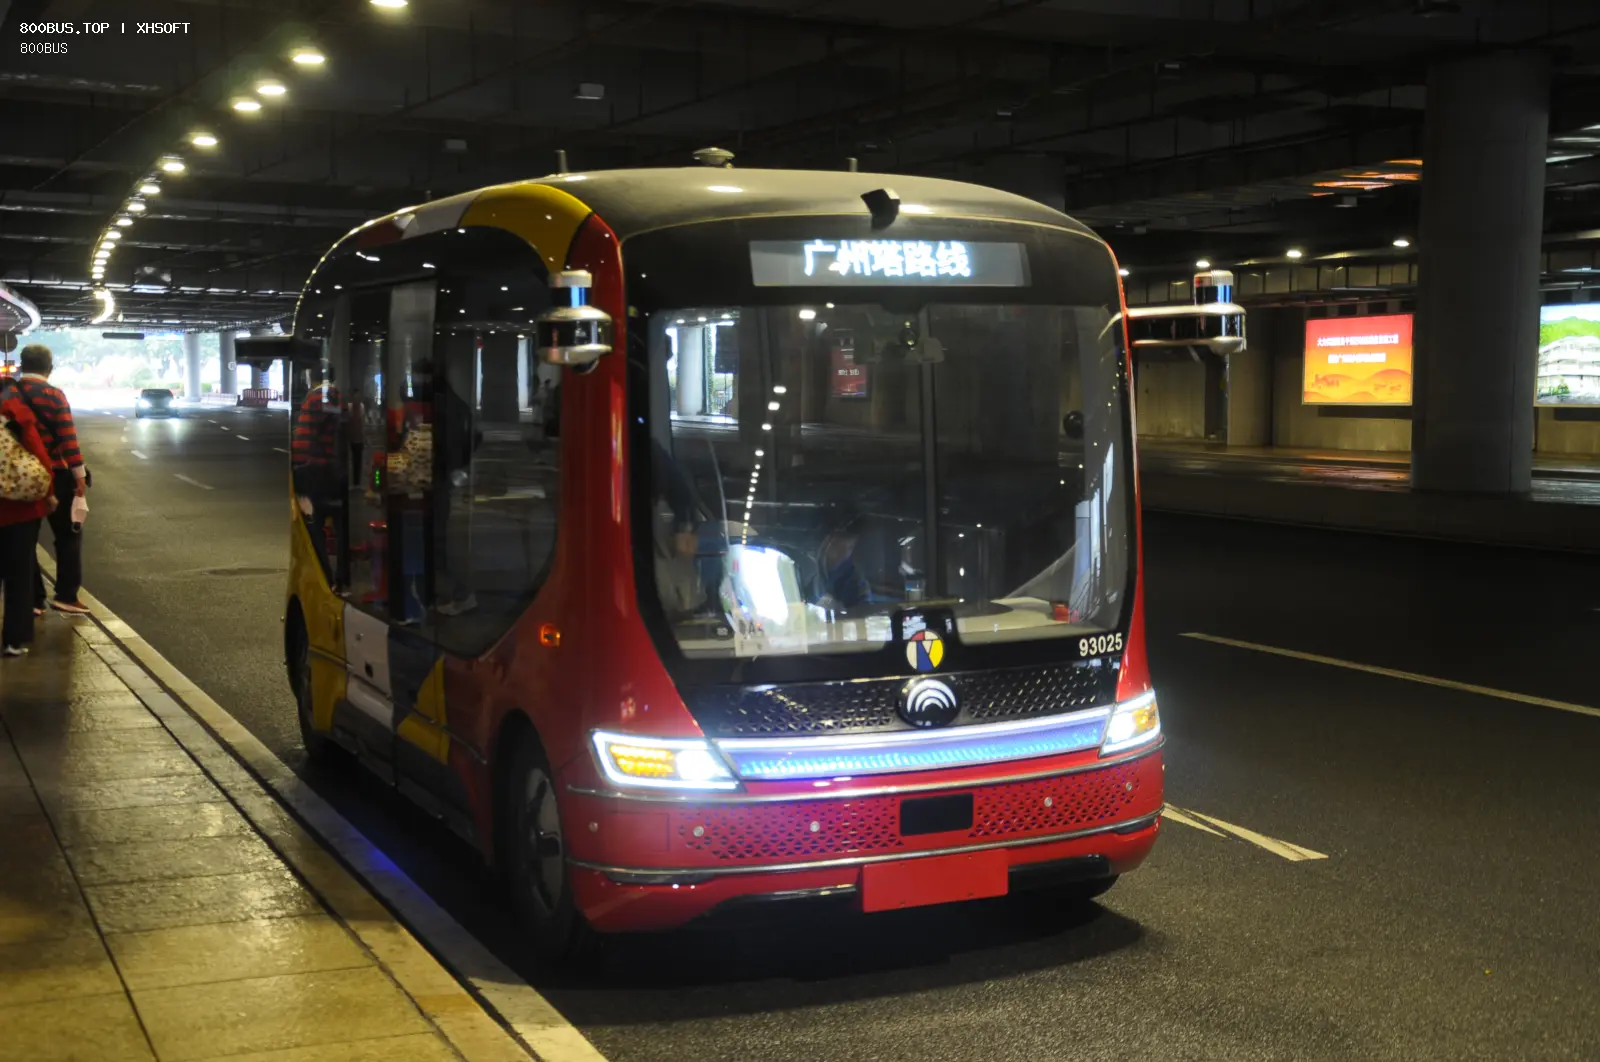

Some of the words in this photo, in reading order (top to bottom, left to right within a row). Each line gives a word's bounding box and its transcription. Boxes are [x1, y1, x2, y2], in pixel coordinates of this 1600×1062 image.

[804, 240, 971, 277] 广州塔路线
[1078, 632, 1123, 657] 93025
